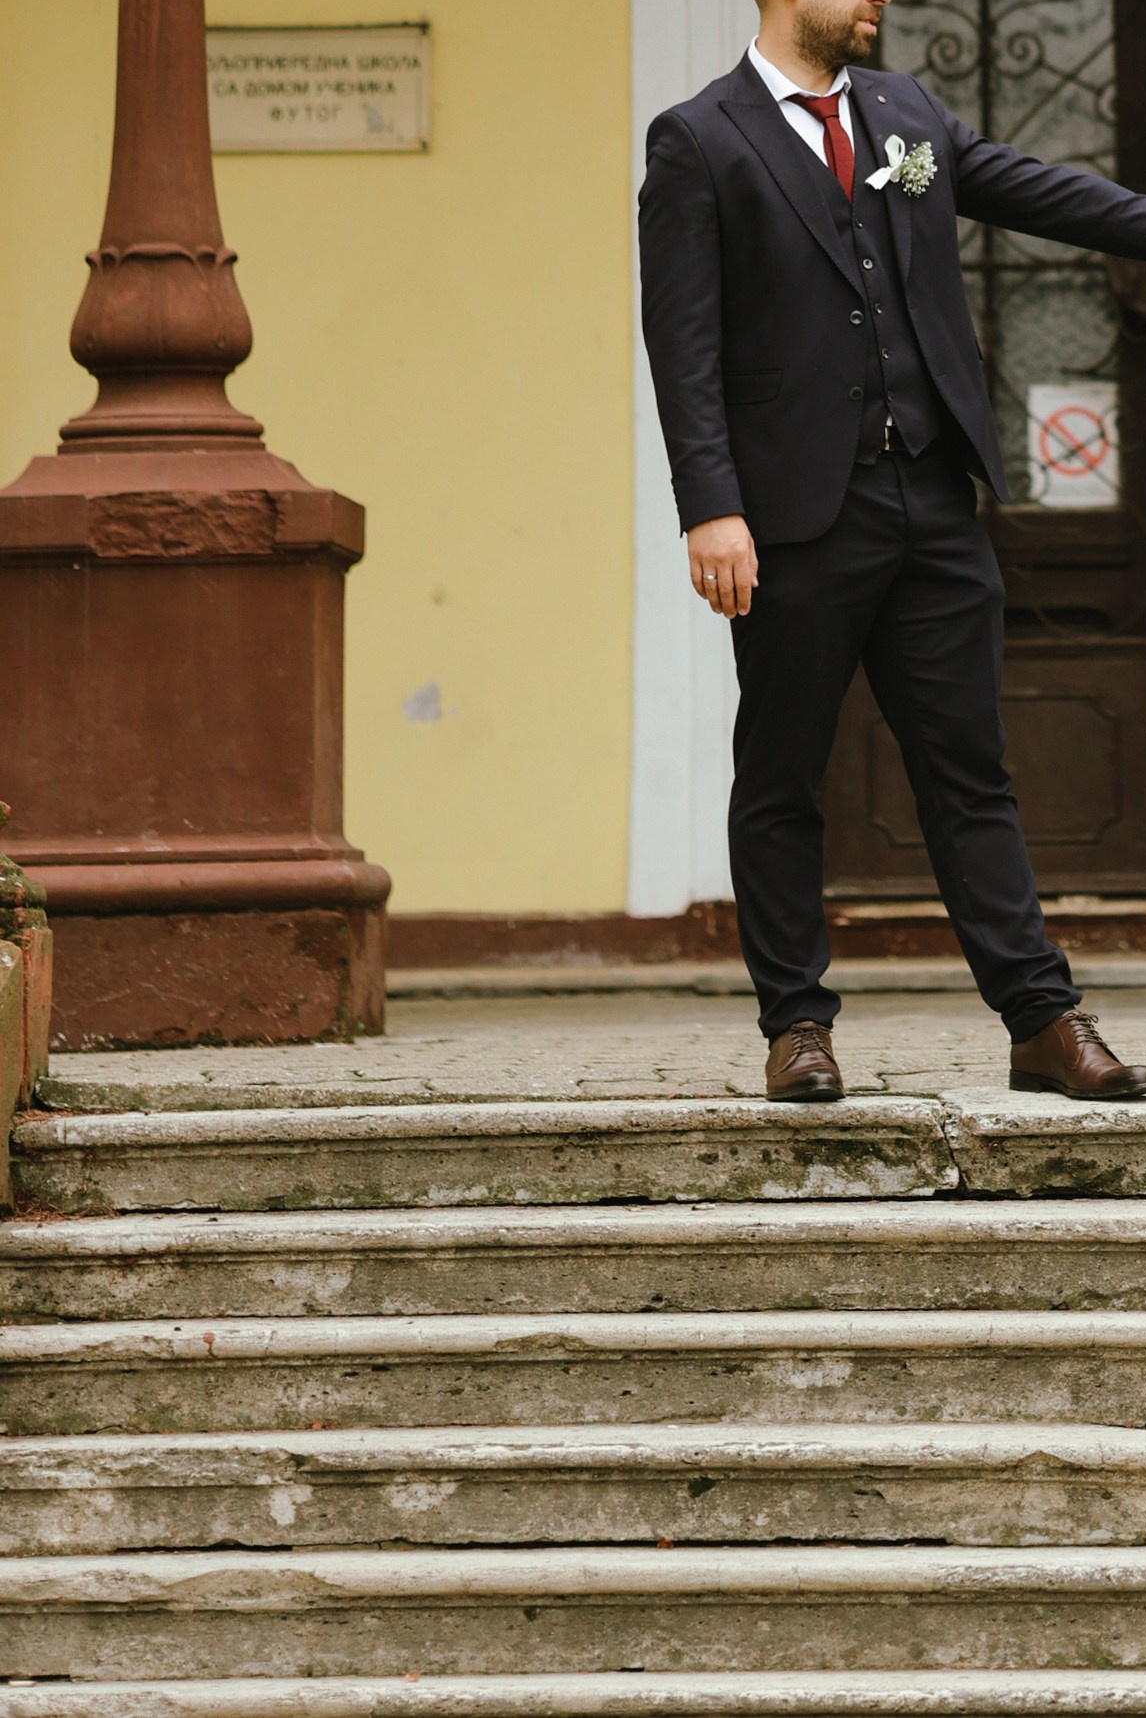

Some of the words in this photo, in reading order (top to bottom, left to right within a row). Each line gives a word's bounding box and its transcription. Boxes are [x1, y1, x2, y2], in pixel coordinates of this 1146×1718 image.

[356, 54, 422, 70] ШКОЛА
[213, 80, 239, 97] СА
[244, 79, 309, 97] ДОМОМ
[315, 78, 396, 96] УЧЕНИКА
